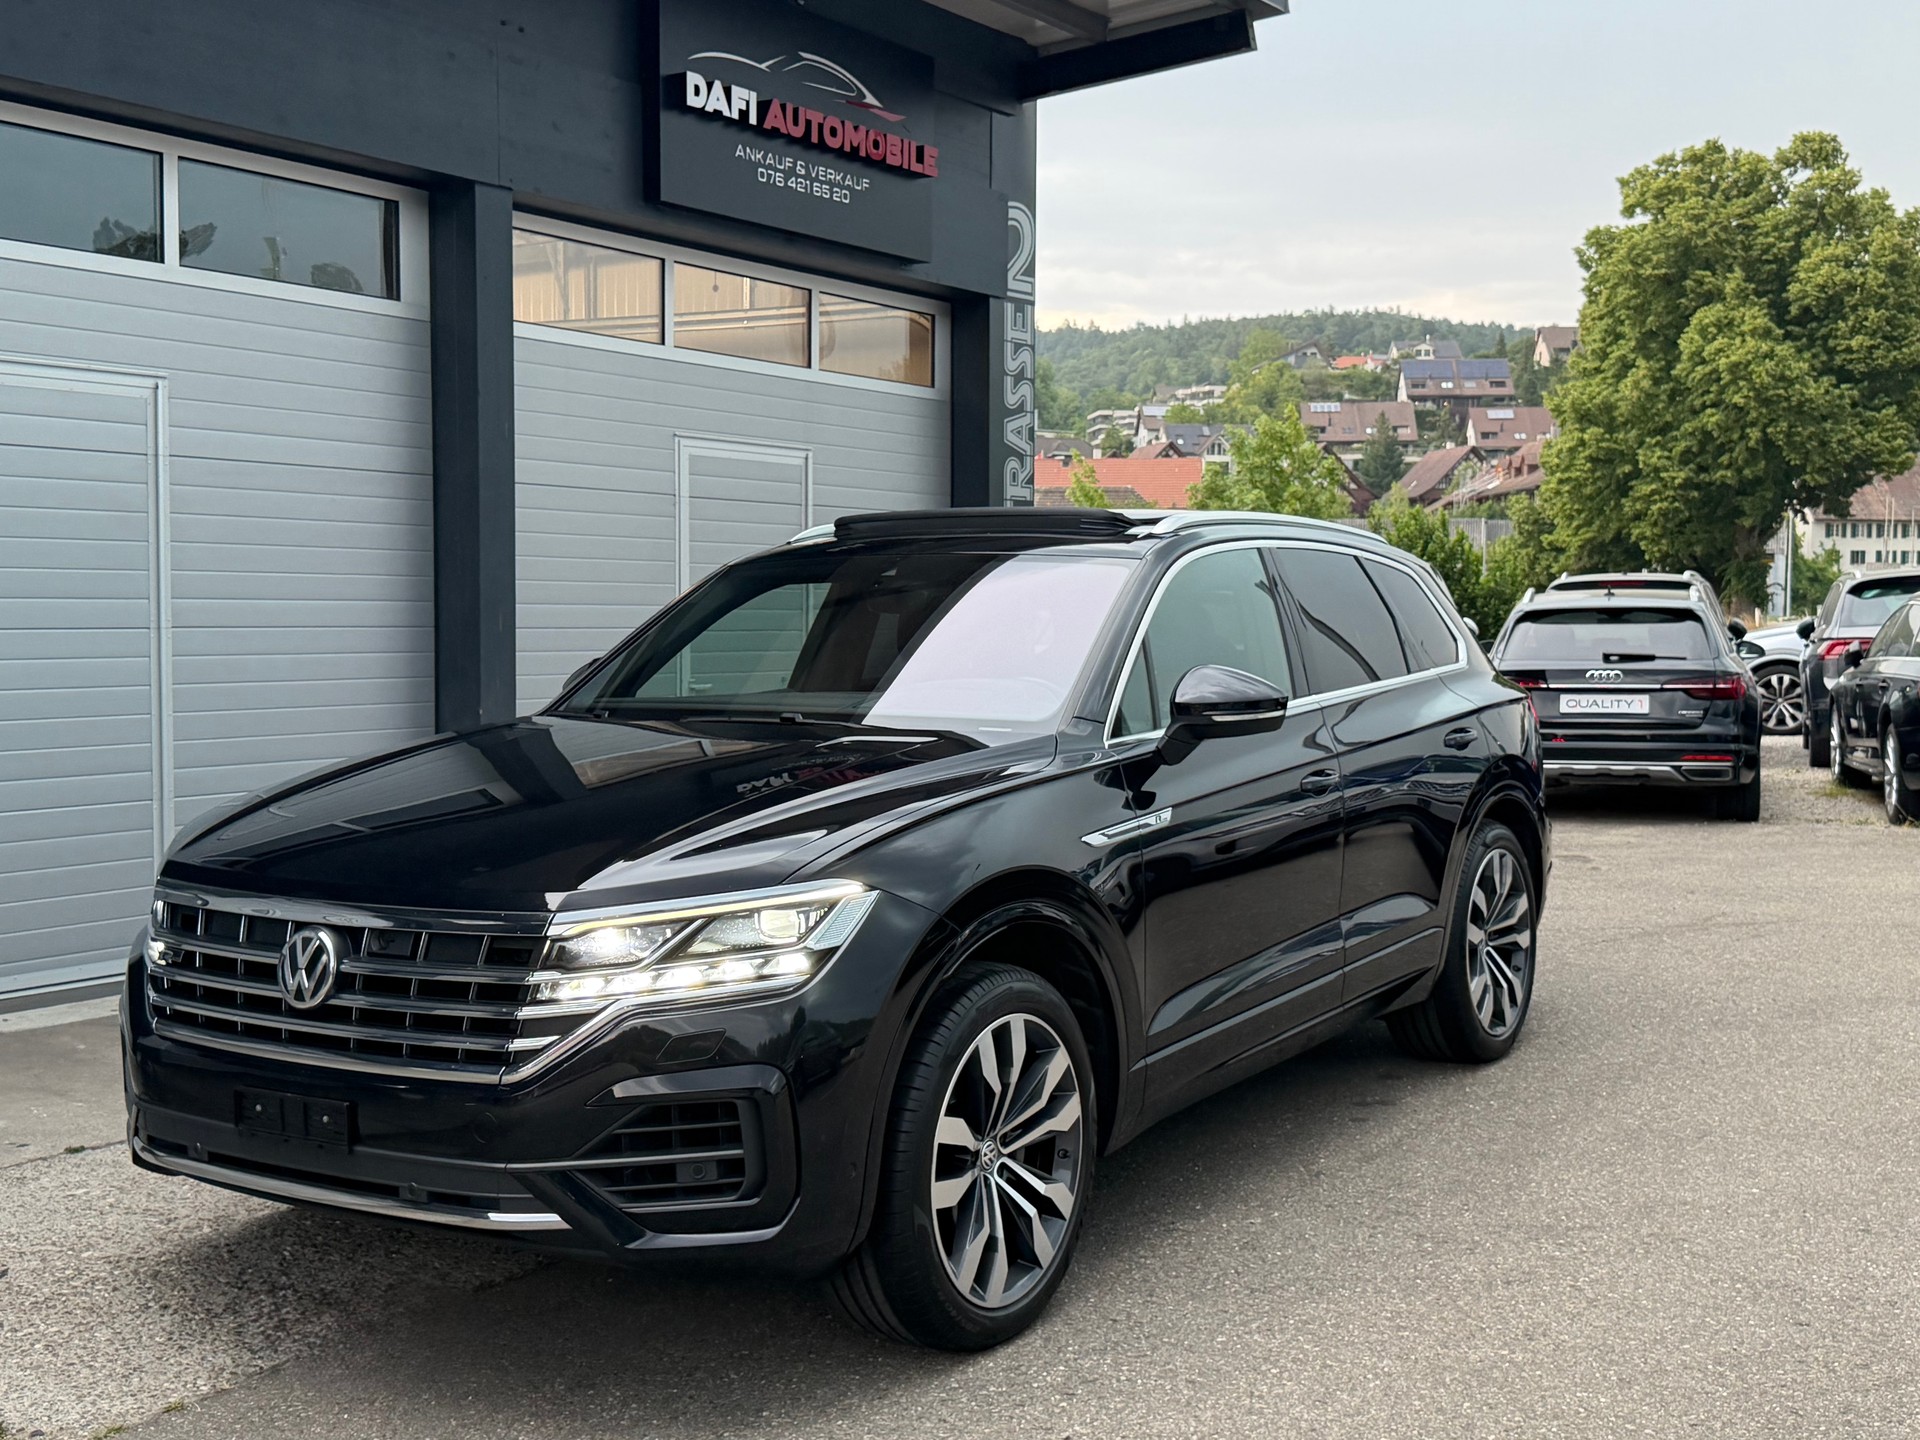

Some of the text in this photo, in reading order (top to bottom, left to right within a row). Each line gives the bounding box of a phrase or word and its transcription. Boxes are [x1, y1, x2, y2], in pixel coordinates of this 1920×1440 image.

[686, 70, 939, 178] DAFI AUTOMOBILE
[735, 144, 870, 191] ANKAUF & VERKAUF
[757, 167, 785, 187] 076
[832, 186, 850, 204] 20
[1003, 301, 1034, 508] RASSE
[1566, 699, 1643, 709] QUALITY 1
